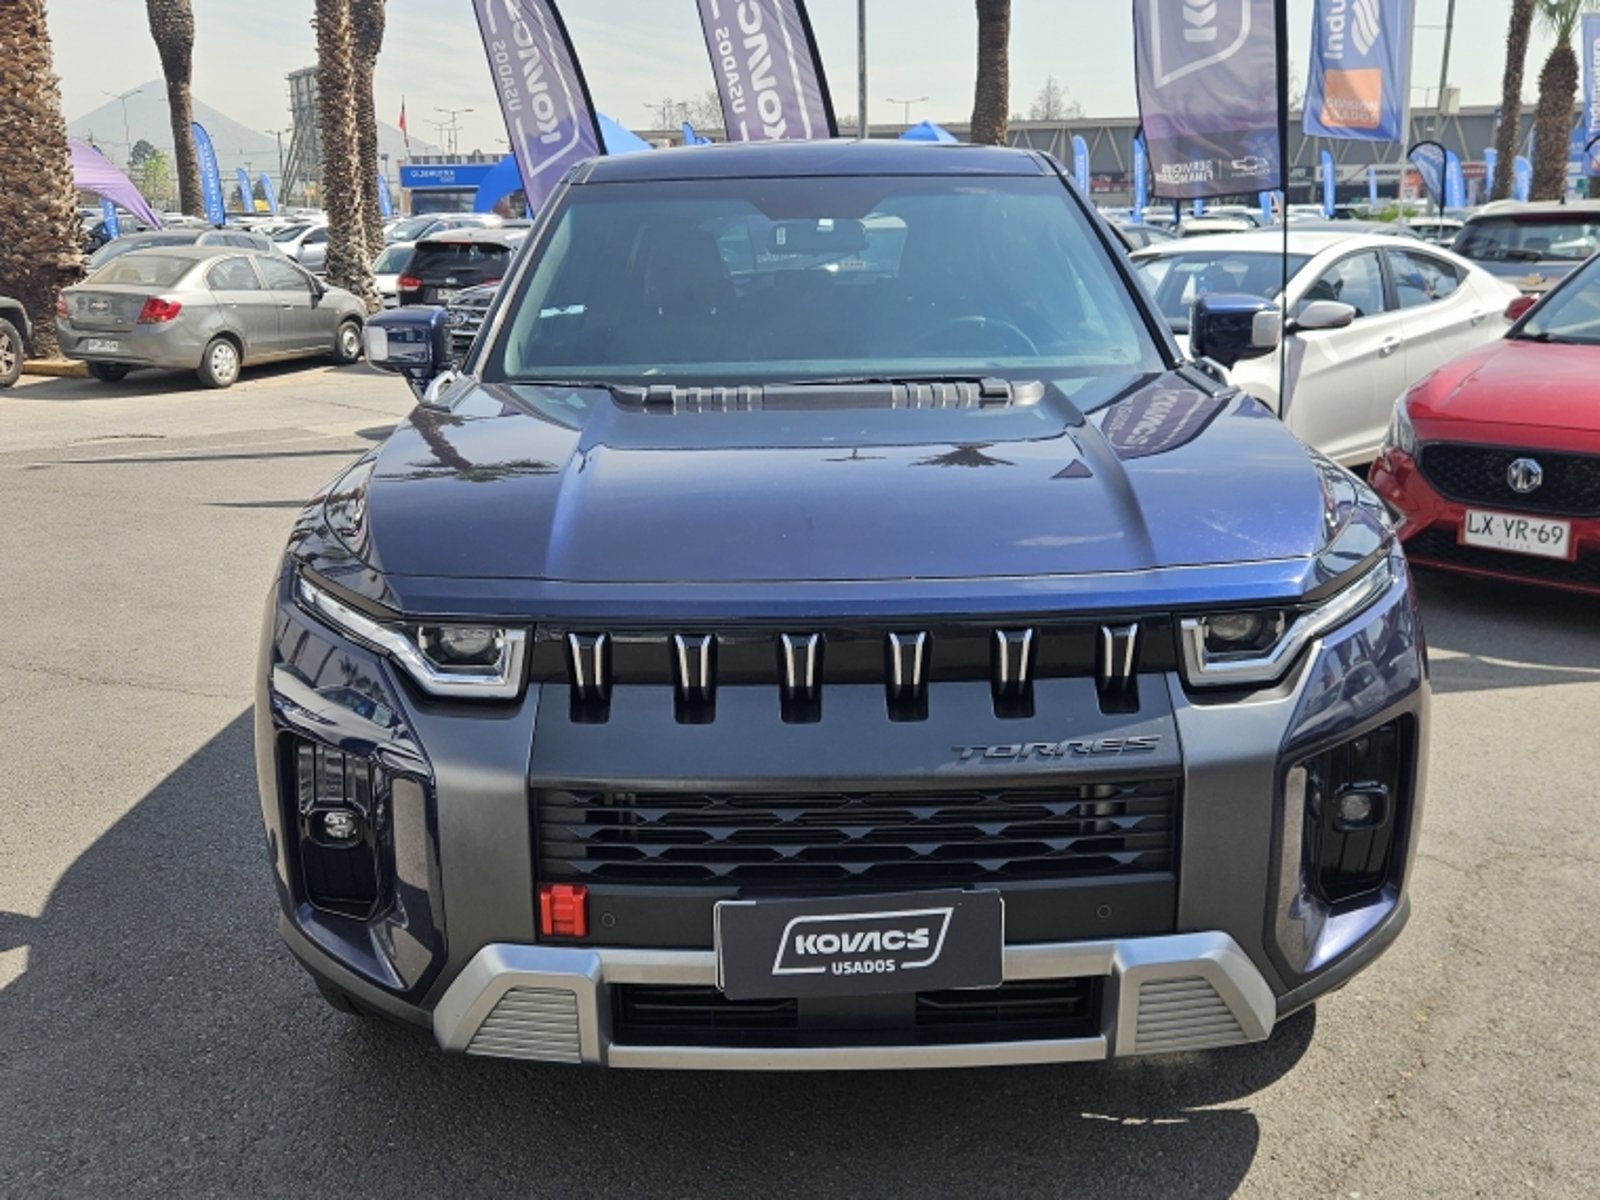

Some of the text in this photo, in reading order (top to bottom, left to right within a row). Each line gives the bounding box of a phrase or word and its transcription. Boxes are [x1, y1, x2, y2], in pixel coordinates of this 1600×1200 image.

[1466, 513, 1493, 535] LX
[951, 735, 1161, 761] TORRES
[795, 927, 930, 955] KOVACS
[831, 959, 896, 976] USADOS
